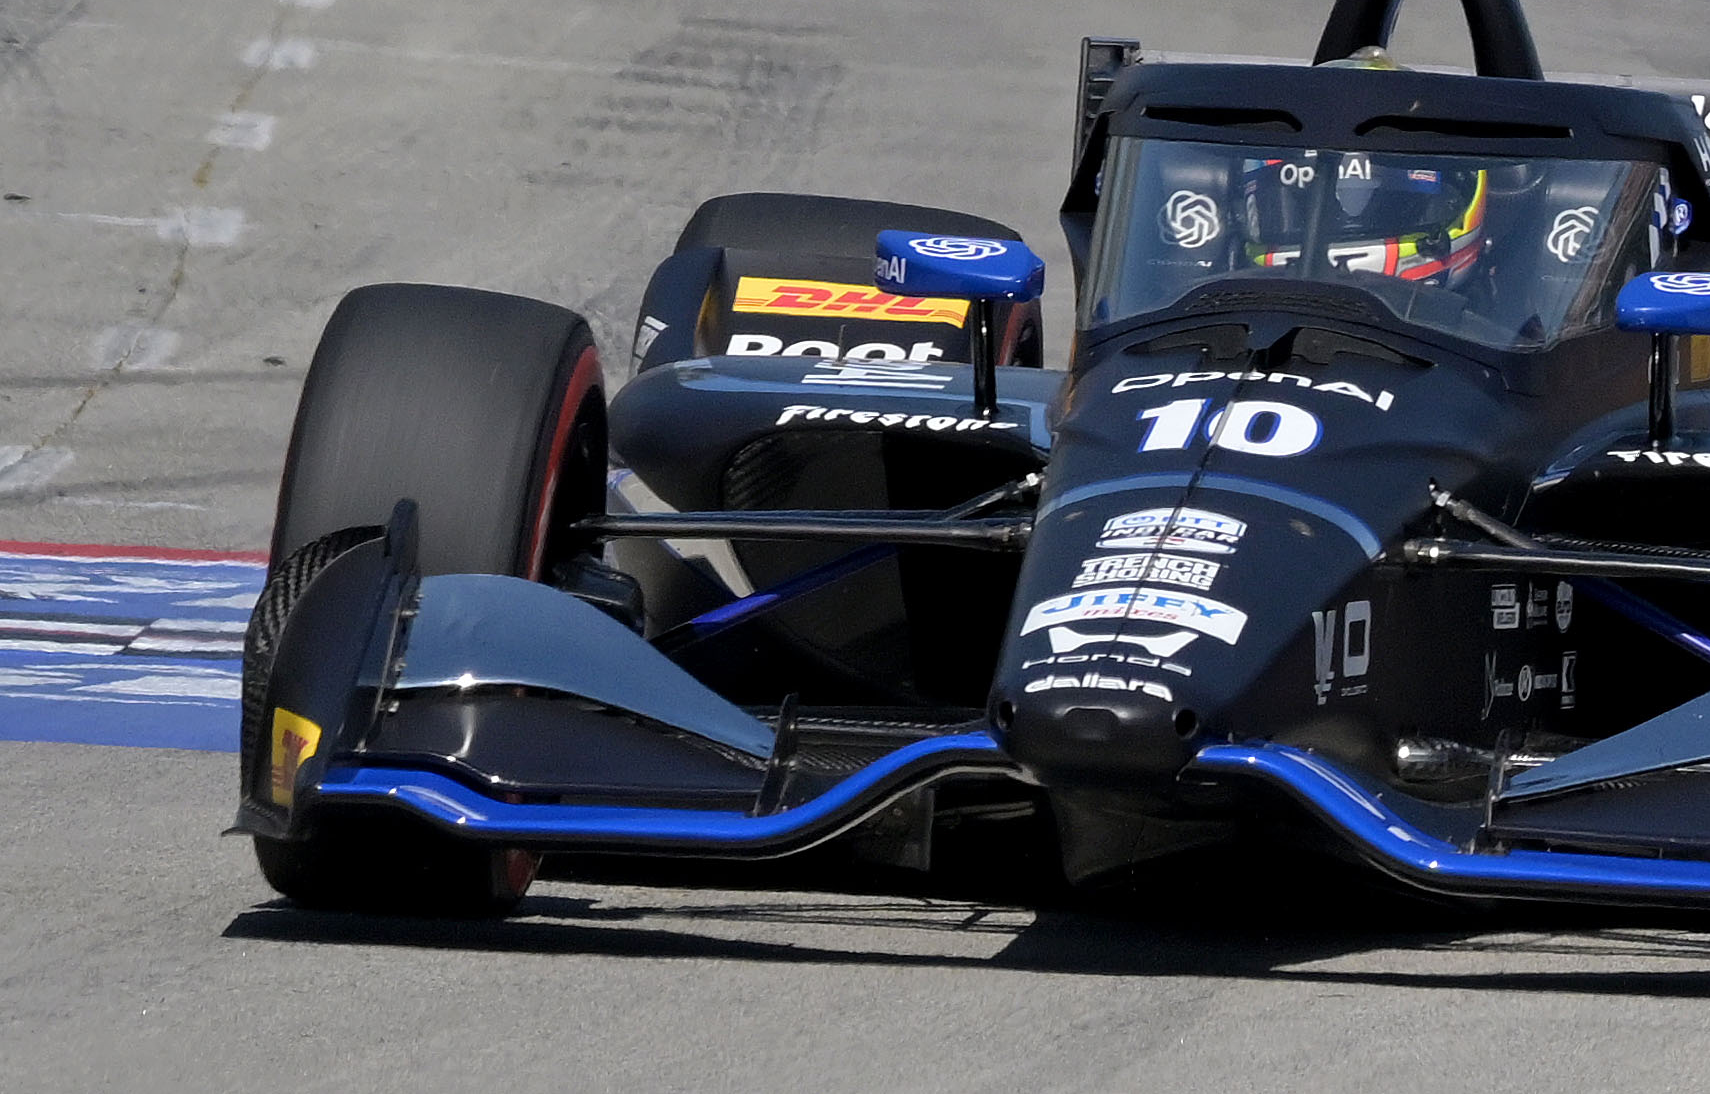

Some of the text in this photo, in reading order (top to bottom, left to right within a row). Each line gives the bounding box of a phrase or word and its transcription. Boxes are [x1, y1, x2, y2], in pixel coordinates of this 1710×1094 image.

[766, 285, 934, 316] DHL
[1111, 371, 1395, 412] OpenAI
[775, 404, 1024, 430] Firestone
[1137, 397, 1325, 457] 10
[1082, 556, 1220, 578] TRENCH
[1024, 672, 1173, 702] dallara
